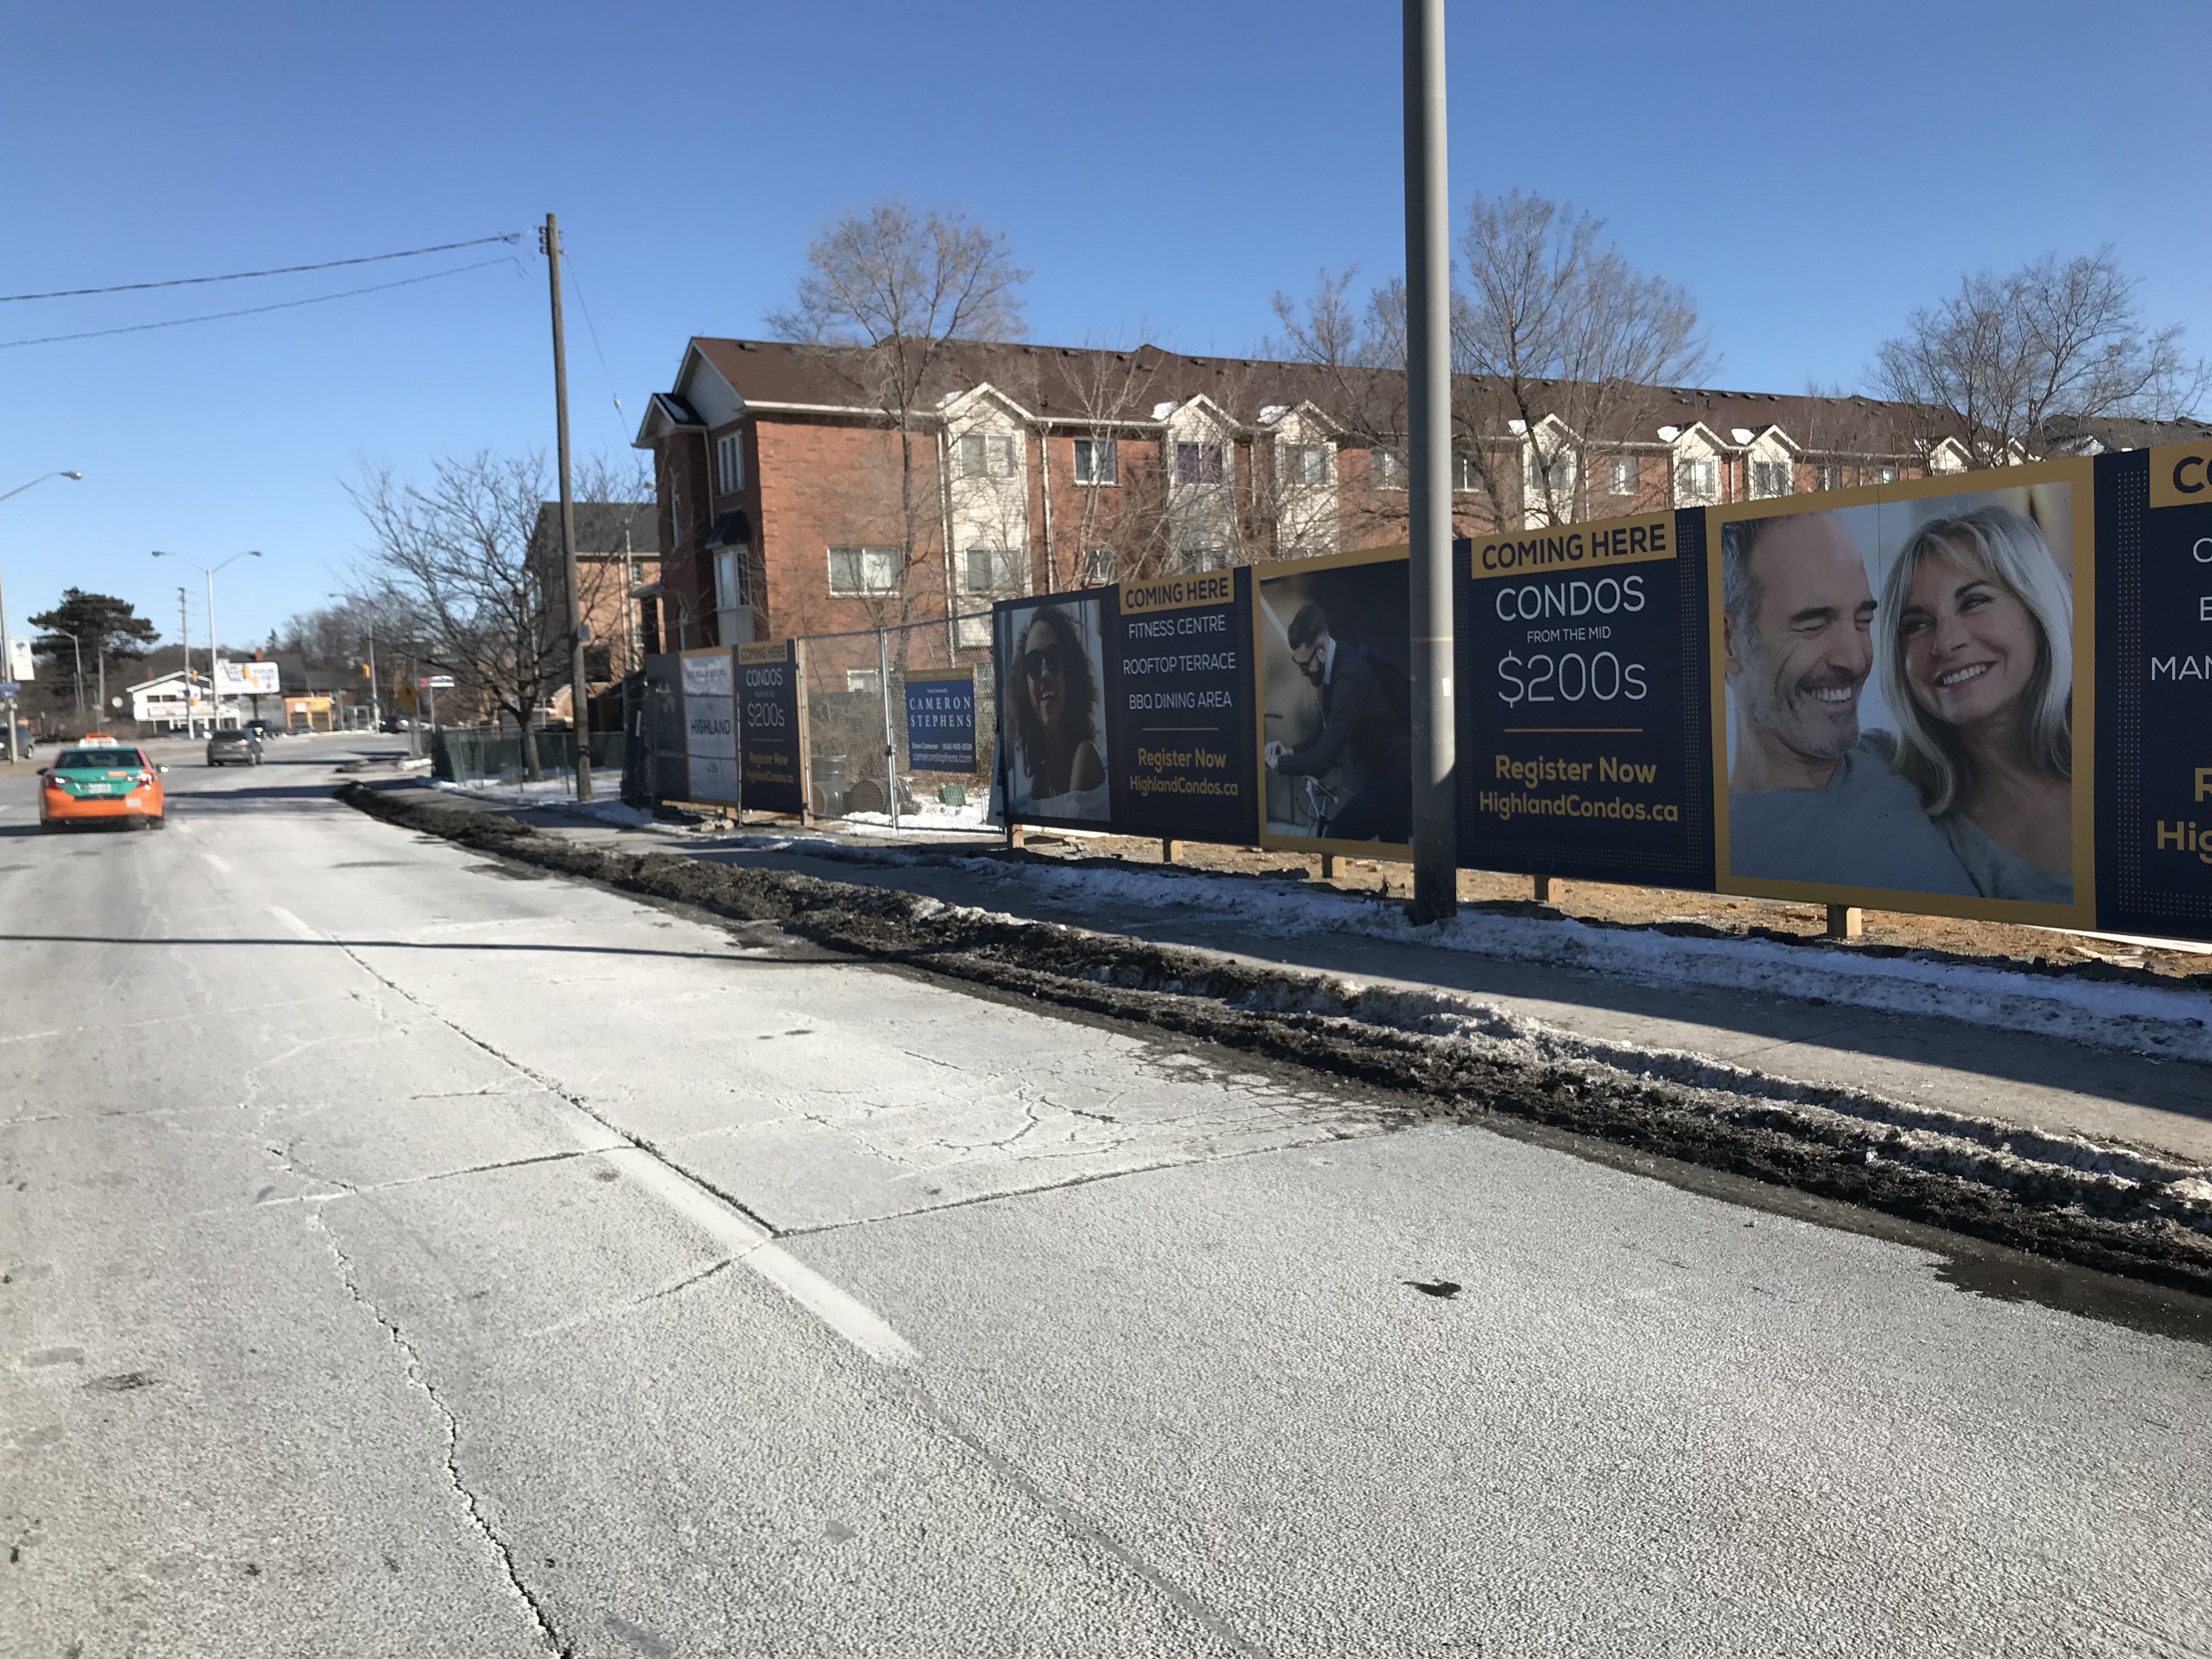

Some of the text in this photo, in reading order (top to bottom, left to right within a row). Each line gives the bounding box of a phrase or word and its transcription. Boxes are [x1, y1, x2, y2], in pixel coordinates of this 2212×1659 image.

[1482, 523, 1666, 570] COMING HERE
[1126, 577, 1228, 608] COMING HERE
[1496, 575, 1645, 622] CONDOS
[1128, 614, 1226, 639] FITNESS CENTRE
[1527, 626, 1611, 643] FROM THE MID
[741, 645, 786, 660] COMING HERE
[1123, 652, 1235, 675] ROOFTOP TERRACE
[746, 668, 782, 687] CONDOS
[1498, 650, 1647, 708] $200s
[909, 696, 971, 710] CAMERON
[1129, 691, 1232, 710] BBQ DINING AREA
[691, 718, 730, 735] HIGHLAND
[748, 701, 785, 729] $200s
[910, 714, 972, 727] STEPHENS
[912, 753, 972, 764] cameronstephens.com
[1138, 747, 1226, 773] Register Now
[1495, 754, 1656, 789] Register Now
[1130, 775, 1238, 797] HighlandCondos.ca
[1480, 791, 1678, 822] HighlandCondos.ca
